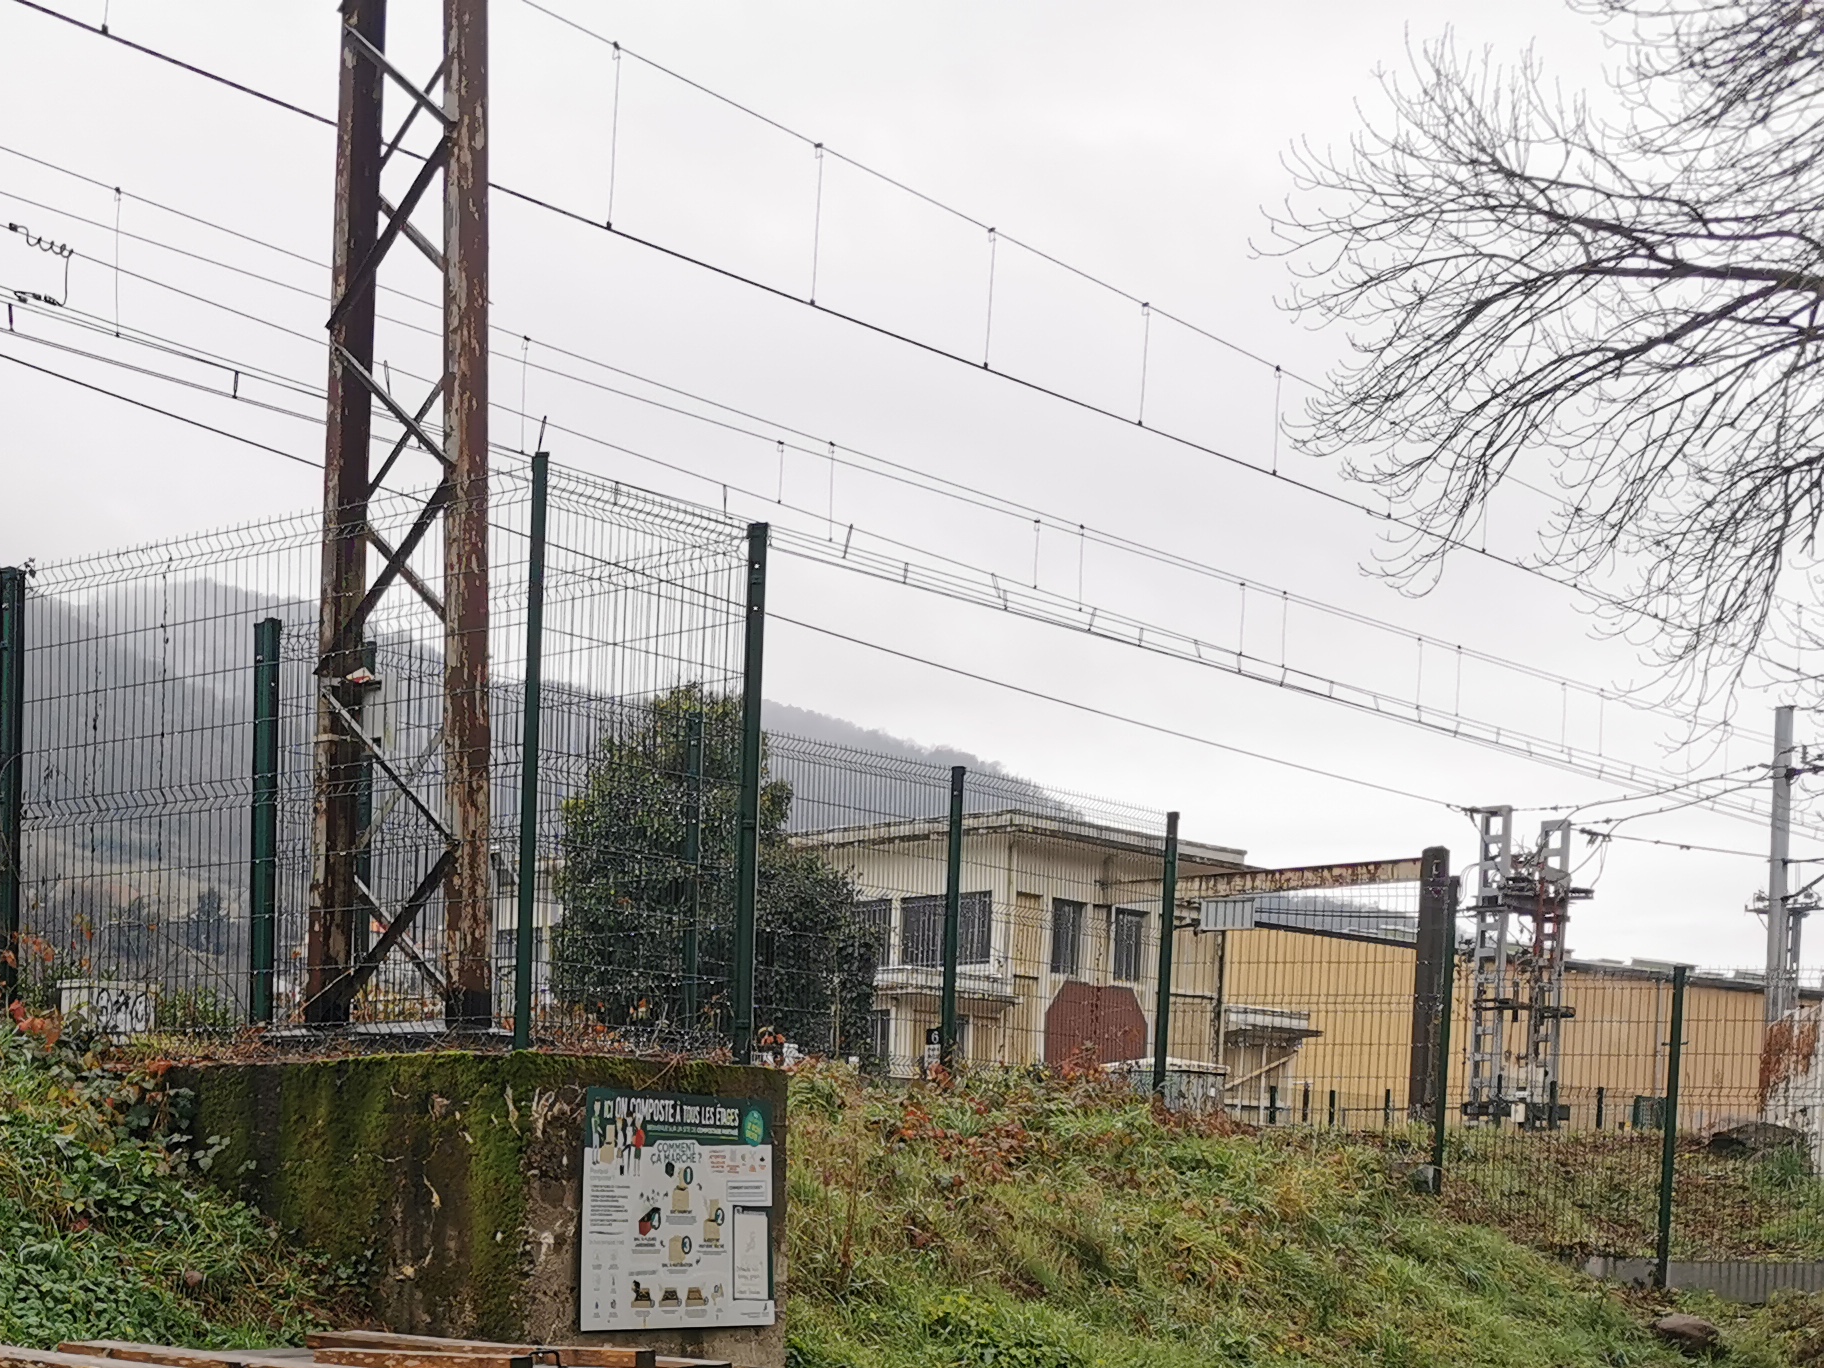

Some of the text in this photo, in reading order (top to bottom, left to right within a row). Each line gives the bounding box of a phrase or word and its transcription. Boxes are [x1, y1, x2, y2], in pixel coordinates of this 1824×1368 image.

[931, 1031, 940, 1044] 6
[615, 1096, 628, 1119] ON
[630, 1097, 675, 1122] COMPOSTE
[676, 1101, 681, 1122] À
[683, 1105, 700, 1124] TOUS
[701, 1106, 714, 1125] LES
[716, 1103, 739, 1127] ÉTAGES
[657, 1142, 696, 1153] COMMENT
[650, 1153, 662, 1166] ÇA
[664, 1152, 696, 1164] MARCHE
[698, 1152, 702, 1164] ?
